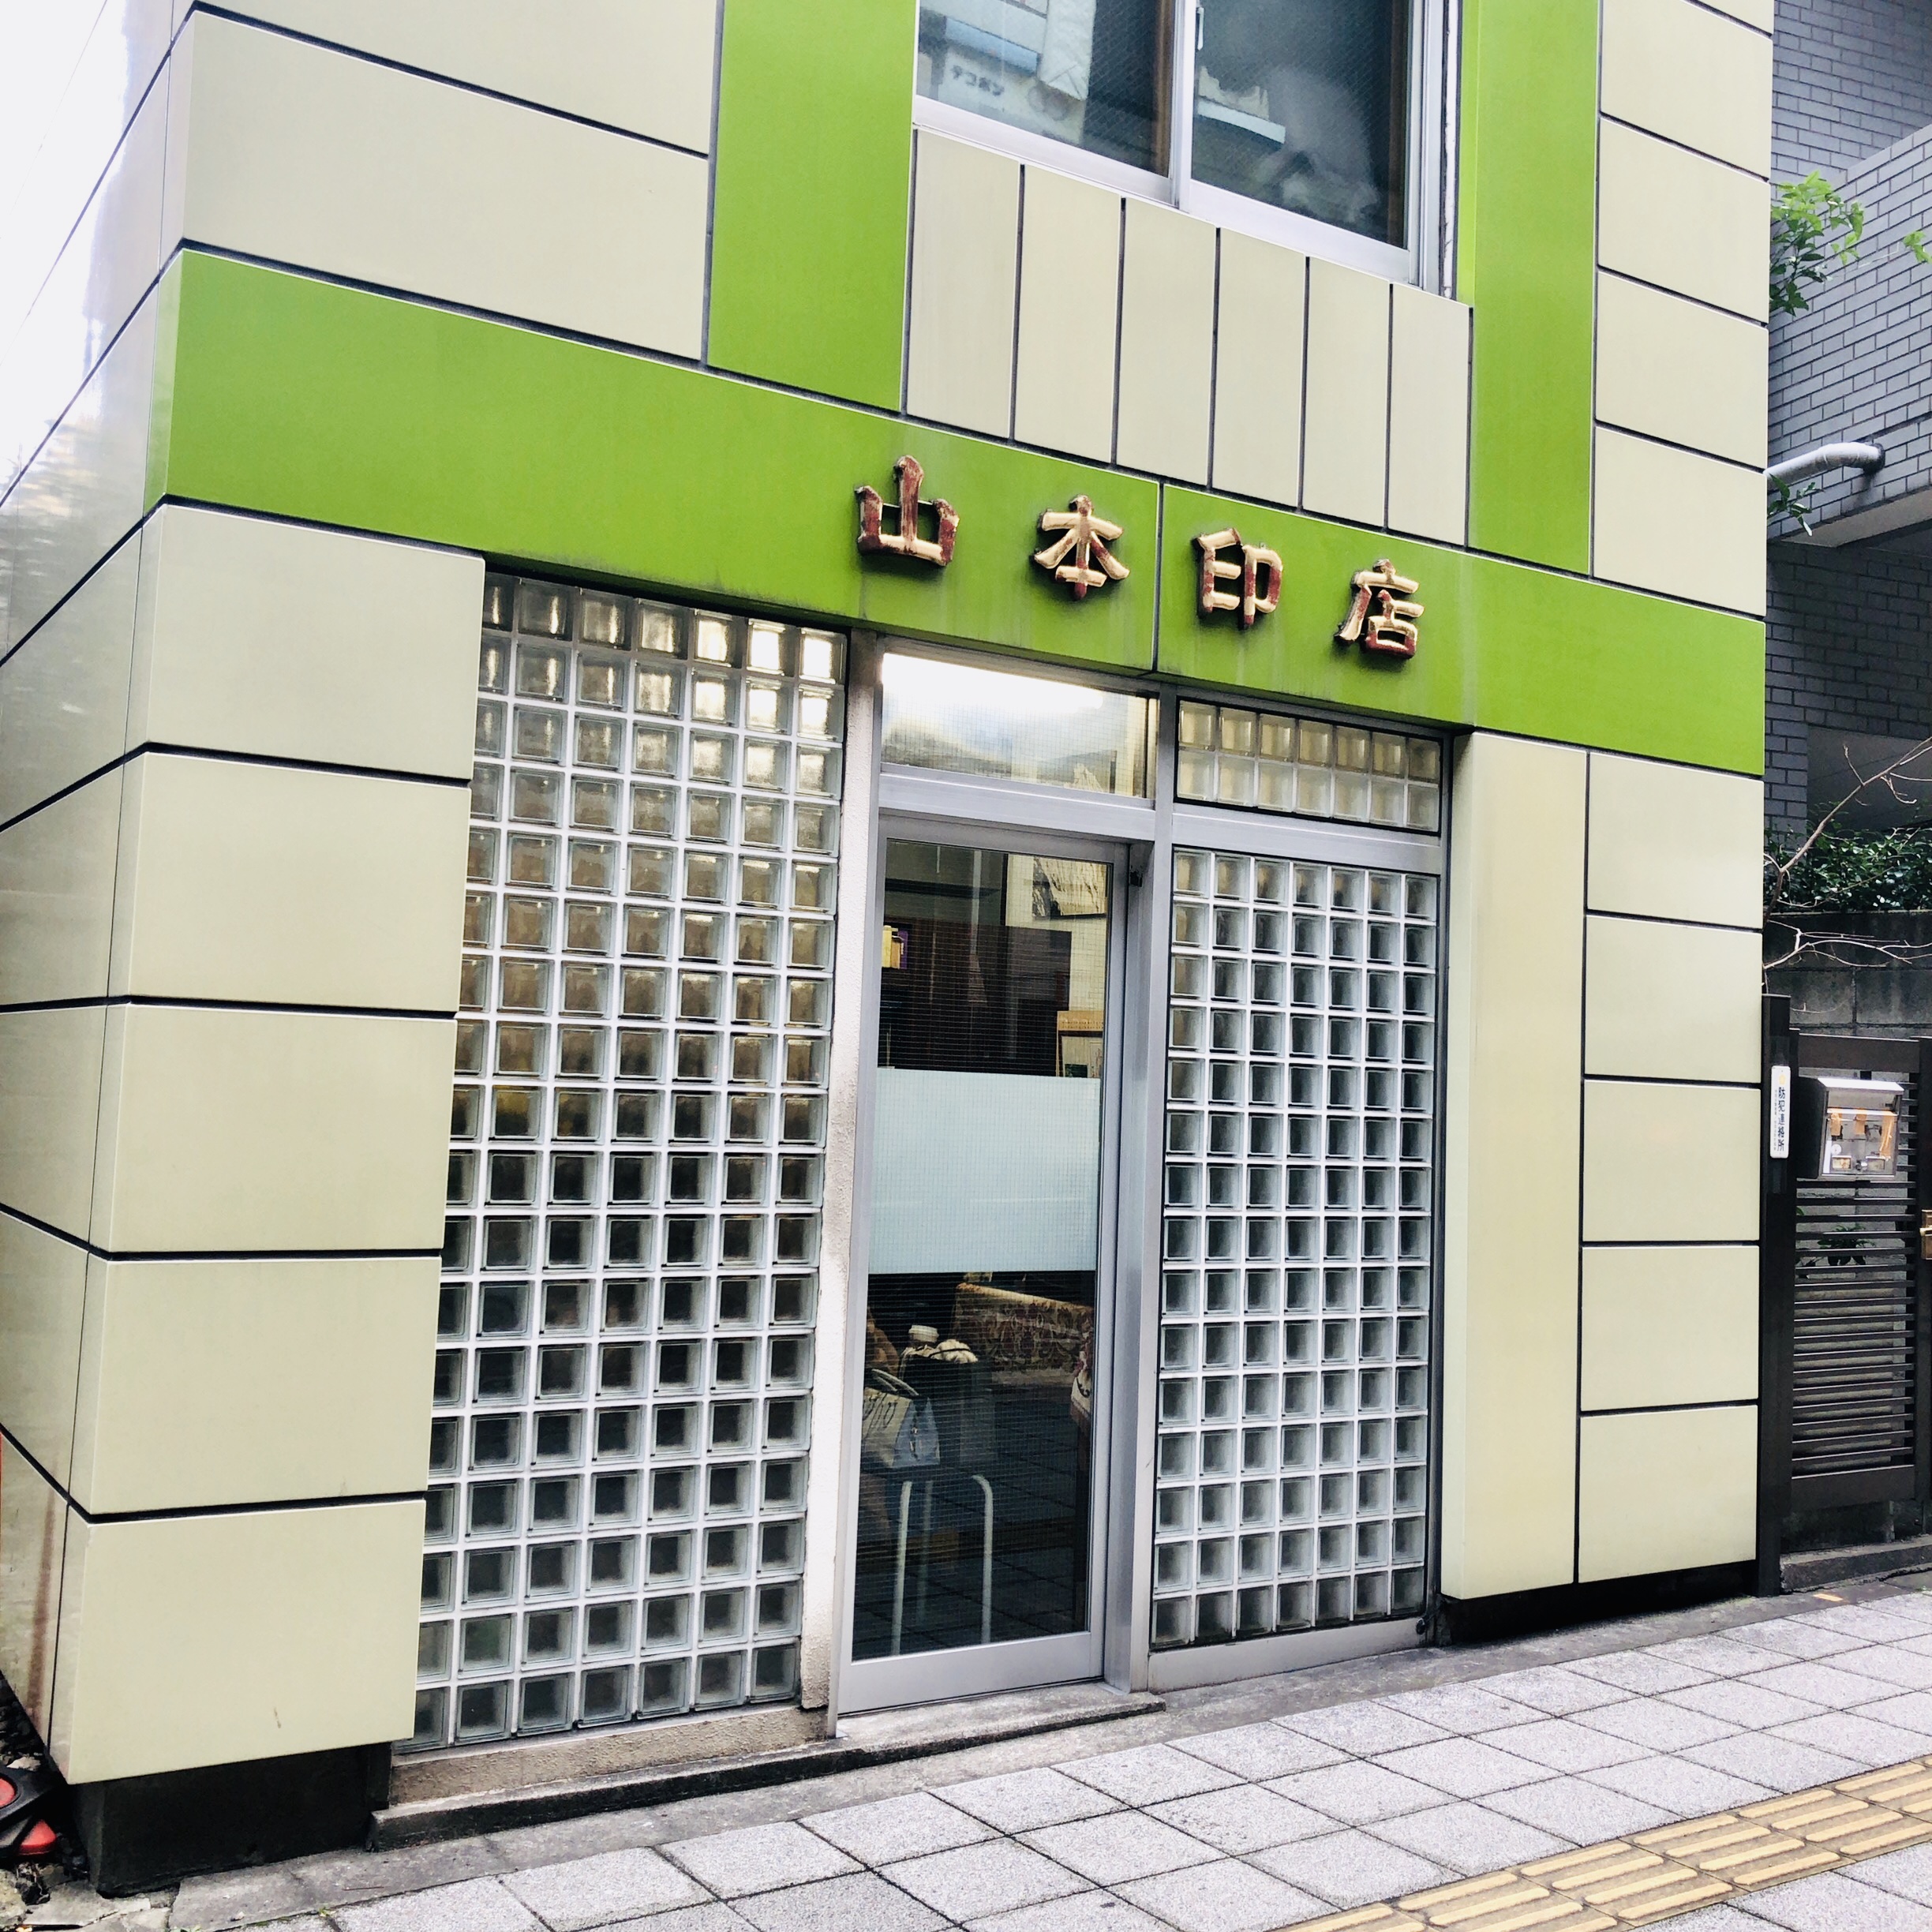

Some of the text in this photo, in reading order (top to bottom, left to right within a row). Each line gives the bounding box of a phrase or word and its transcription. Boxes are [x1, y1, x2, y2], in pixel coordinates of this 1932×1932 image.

[856, 455, 1424, 658] 山本印店
[1777, 1086, 1786, 1152] 防犯連絡所
